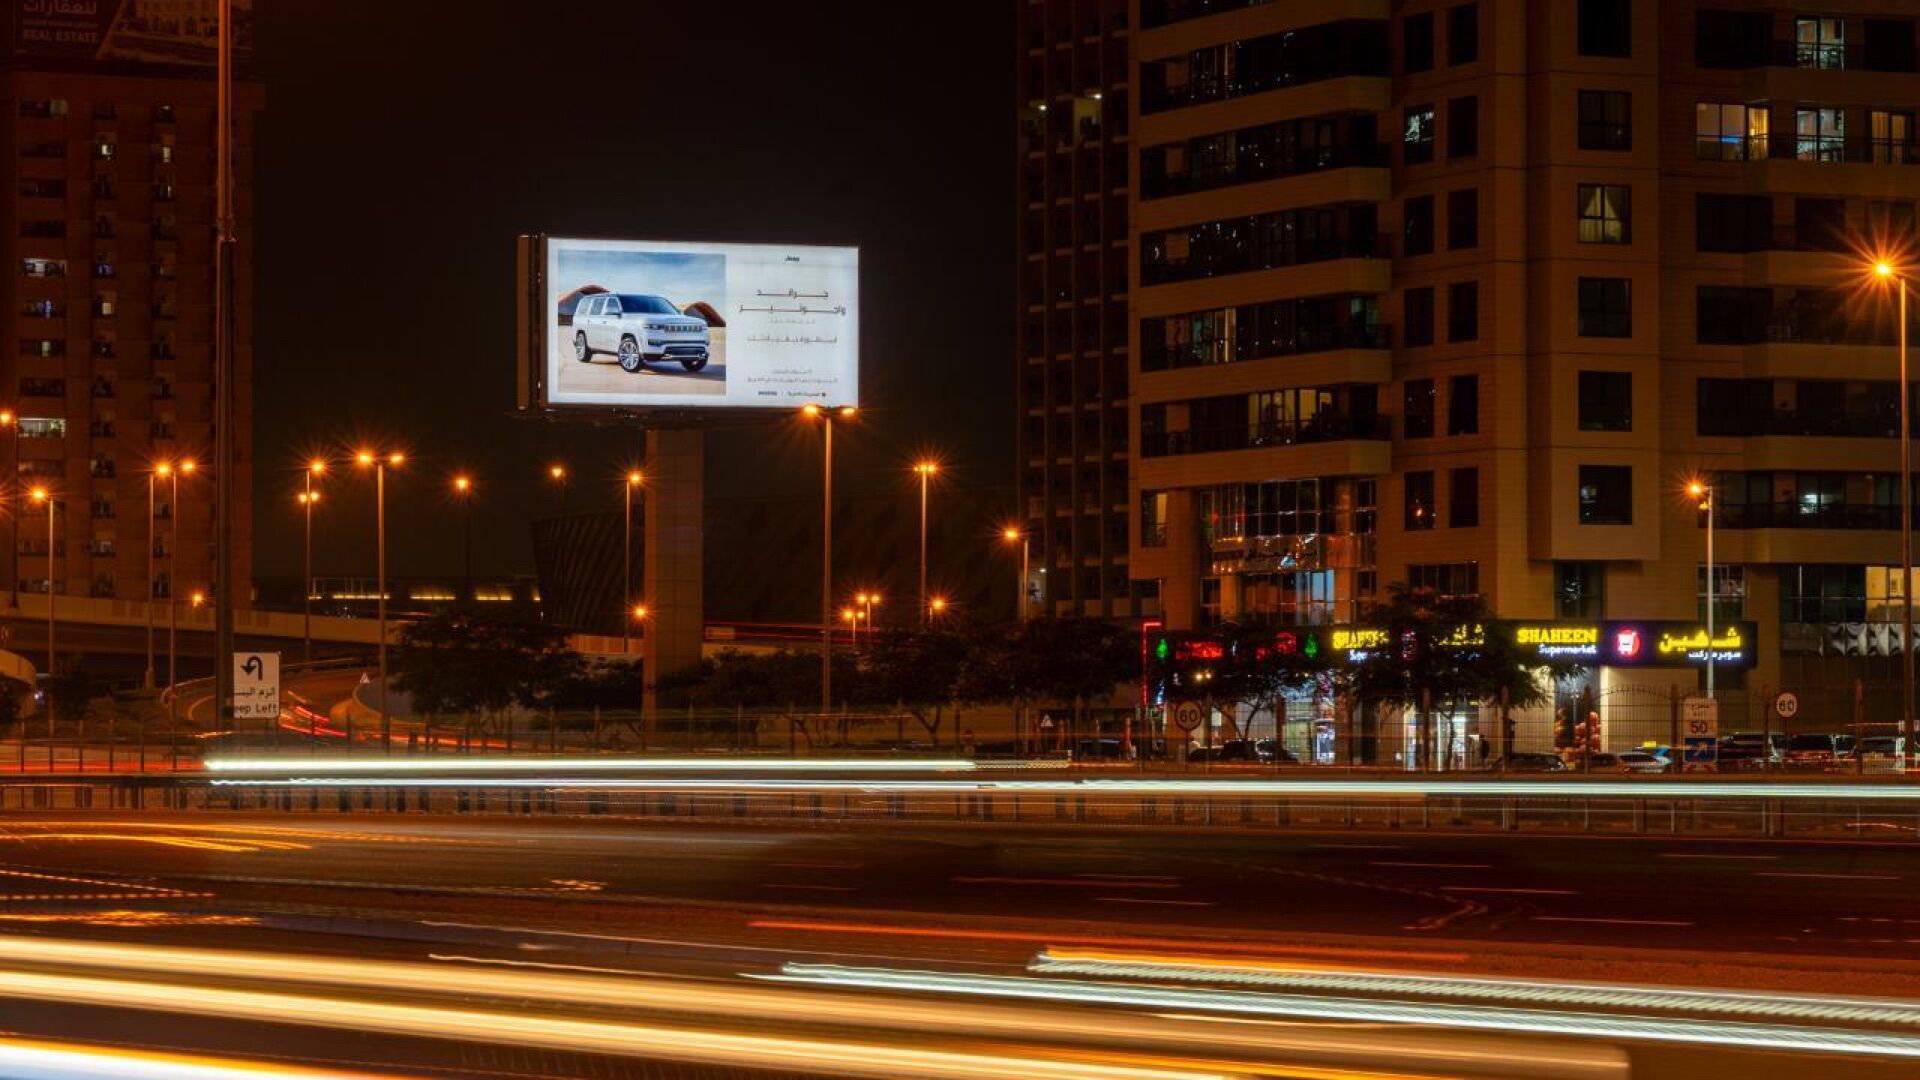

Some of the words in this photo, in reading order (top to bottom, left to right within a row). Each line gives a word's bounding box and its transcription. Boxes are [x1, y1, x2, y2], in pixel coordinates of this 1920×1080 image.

[23, 29, 53, 40] REAL
[56, 31, 97, 43] ESTATE
[1516, 628, 1598, 643] SHAHEEN
[1538, 643, 1598, 657] Supermarket
[256, 703, 277, 714] Left
[1779, 700, 1794, 712] 60
[1180, 710, 1198, 722] 60
[1691, 720, 1708, 733] 50
